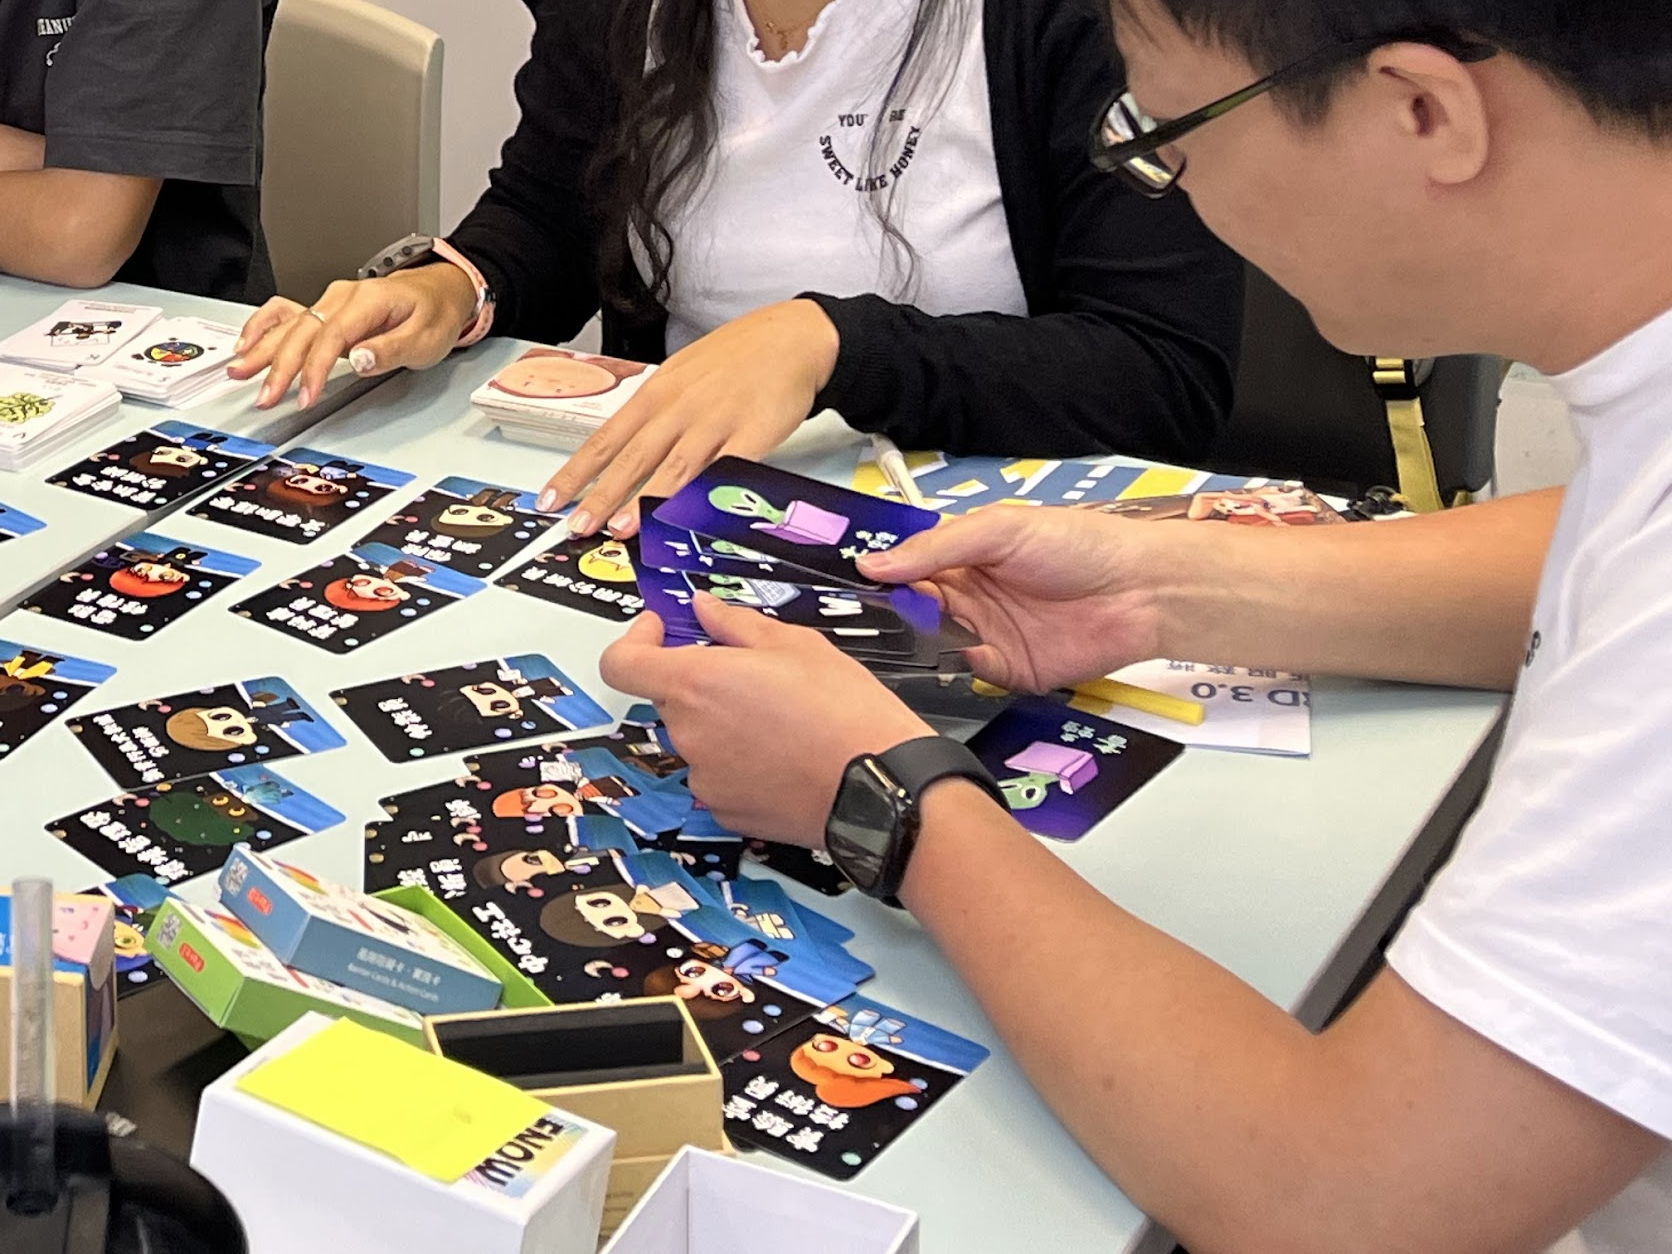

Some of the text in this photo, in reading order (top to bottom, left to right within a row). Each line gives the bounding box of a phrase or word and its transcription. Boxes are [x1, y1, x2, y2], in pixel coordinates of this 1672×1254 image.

[838, 113, 865, 128] YOU
[819, 125, 921, 192] SWEET LIKE HONEY
[1190, 682, 1255, 703] 3.0
[471, 902, 550, 976] 中心社工
[722, 1095, 824, 1153] 實驗室
[744, 1075, 849, 1130] 技術員
